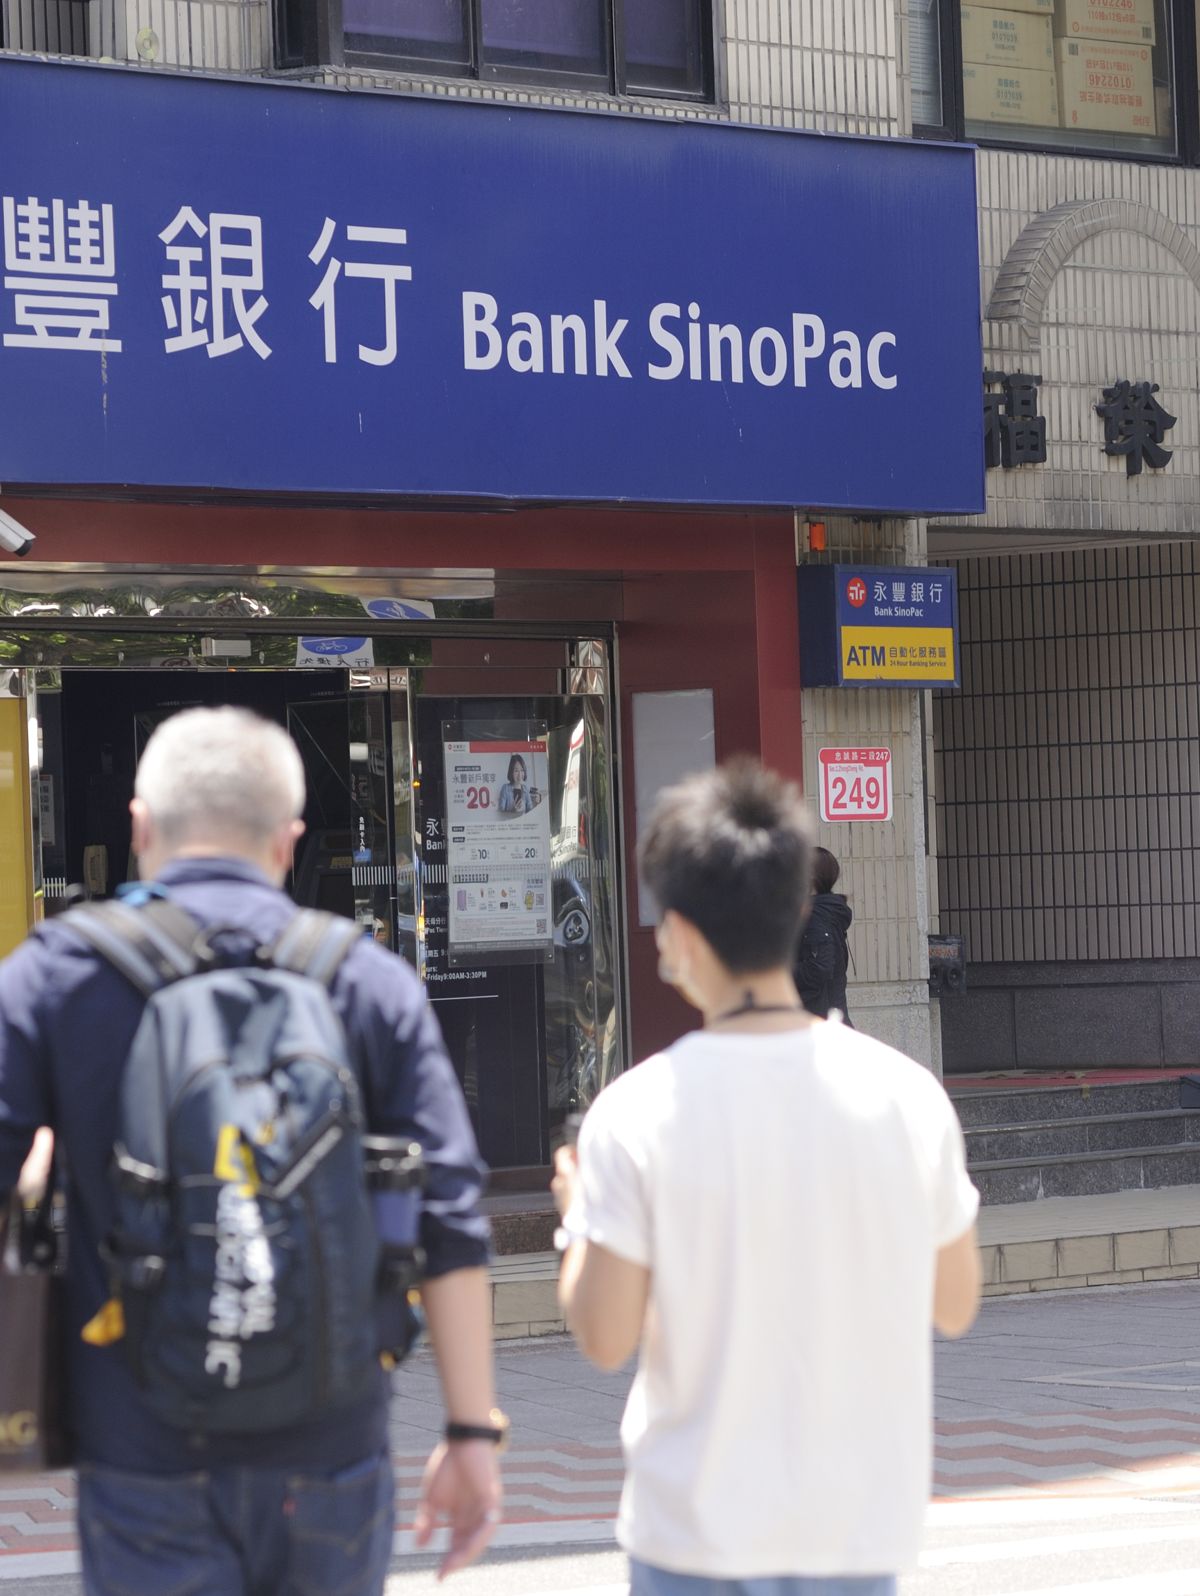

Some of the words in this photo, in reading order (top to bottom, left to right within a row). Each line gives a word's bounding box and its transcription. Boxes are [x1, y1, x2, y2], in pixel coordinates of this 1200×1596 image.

[2, 196, 412, 367] 豐銀行
[462, 291, 633, 378] Bank
[648, 301, 898, 390] SinoPac
[873, 581, 943, 603] 永豐銀行
[874, 606, 893, 616] Bank
[894, 606, 924, 617] SinoPac
[846, 645, 886, 667] ATM
[889, 646, 947, 658] 自動化服務區
[875, 751, 889, 760] 247
[832, 776, 880, 810] 249
[525, 847, 536, 858] 20
